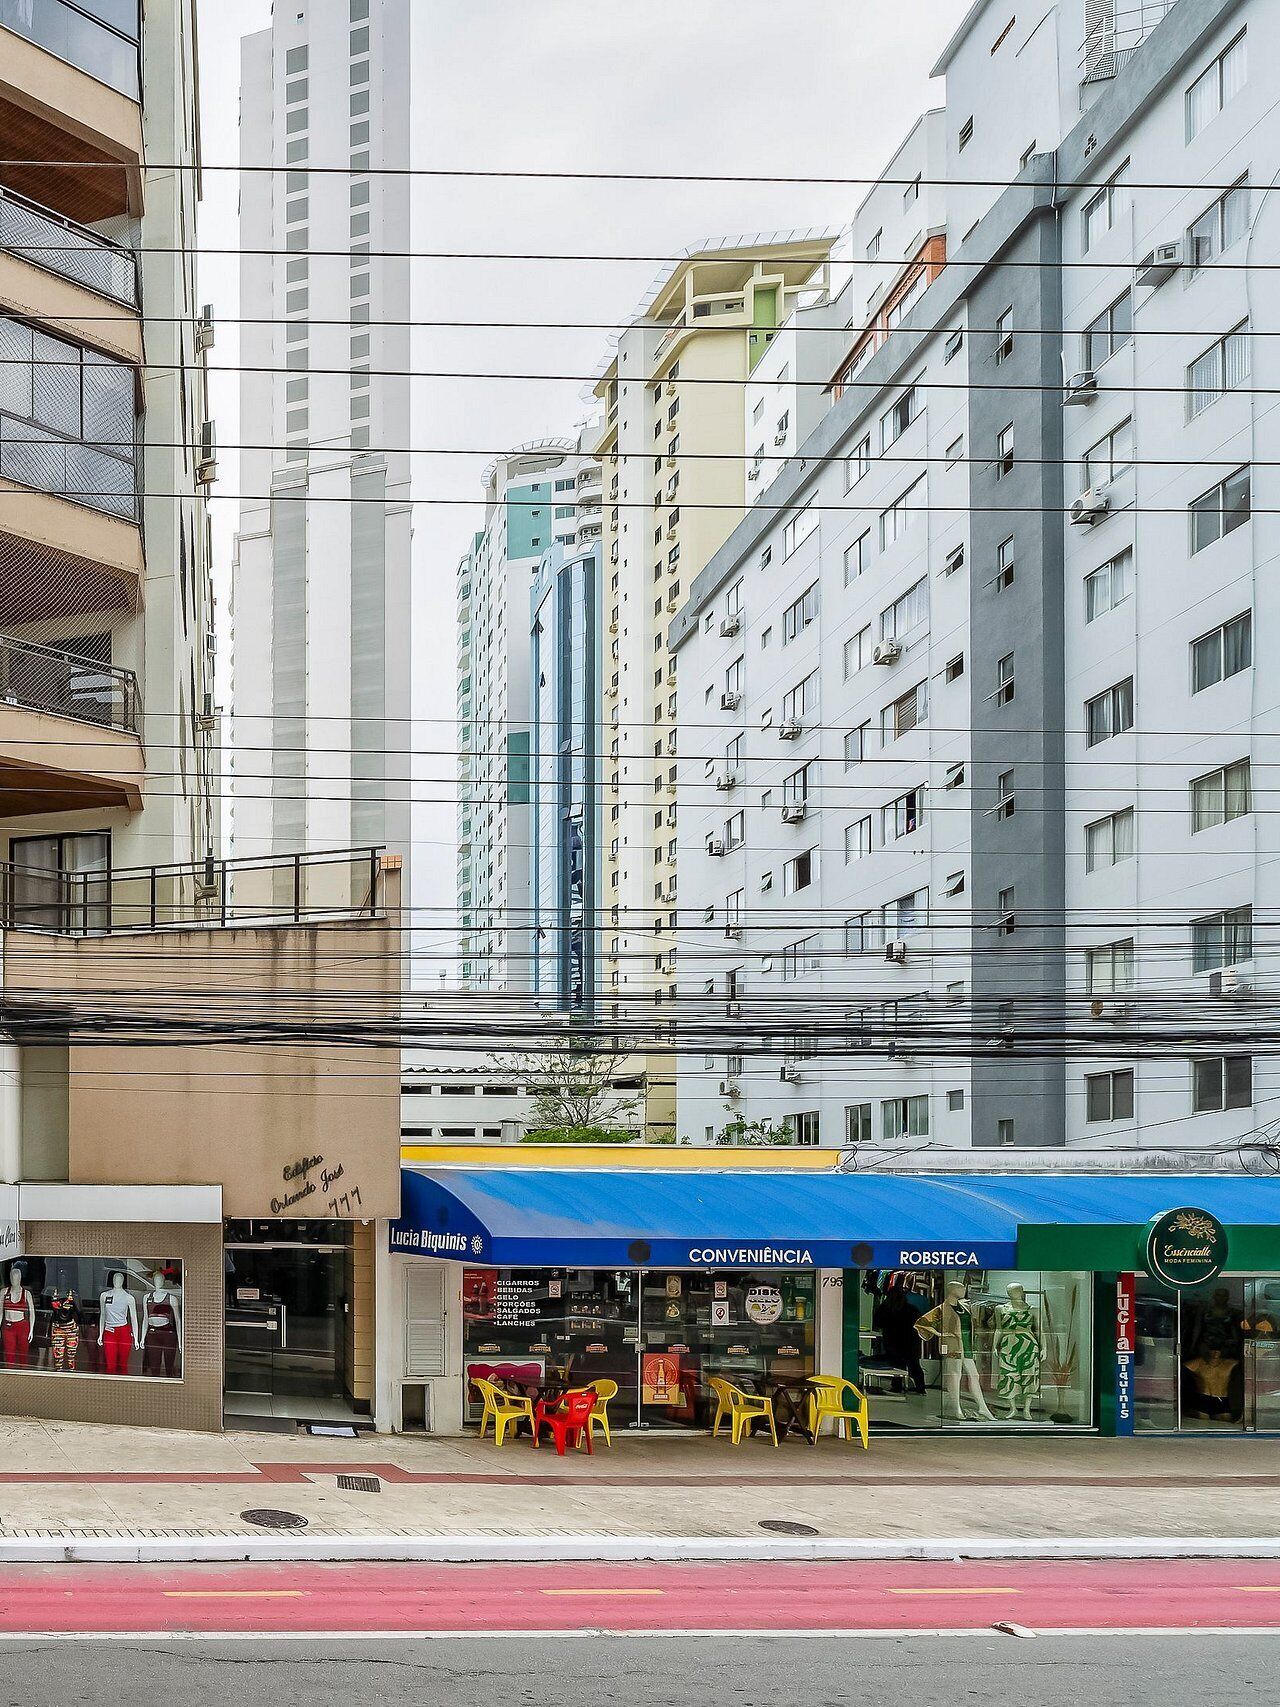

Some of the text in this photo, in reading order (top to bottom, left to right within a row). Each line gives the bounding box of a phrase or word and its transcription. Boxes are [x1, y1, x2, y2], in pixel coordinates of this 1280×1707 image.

[270, 1181, 316, 1214] Orlando
[328, 1186, 362, 1217] 777
[391, 1227, 467, 1252] Lucia Biquinis
[688, 1246, 813, 1264] CONVENIÊNCIA
[900, 1251, 979, 1265] ROBSTECA
[822, 1276, 844, 1288] 795
[749, 1288, 780, 1296] DISK
[497, 1300, 536, 1309] PORÇÕES
[1116, 1281, 1129, 1350] Lucia
